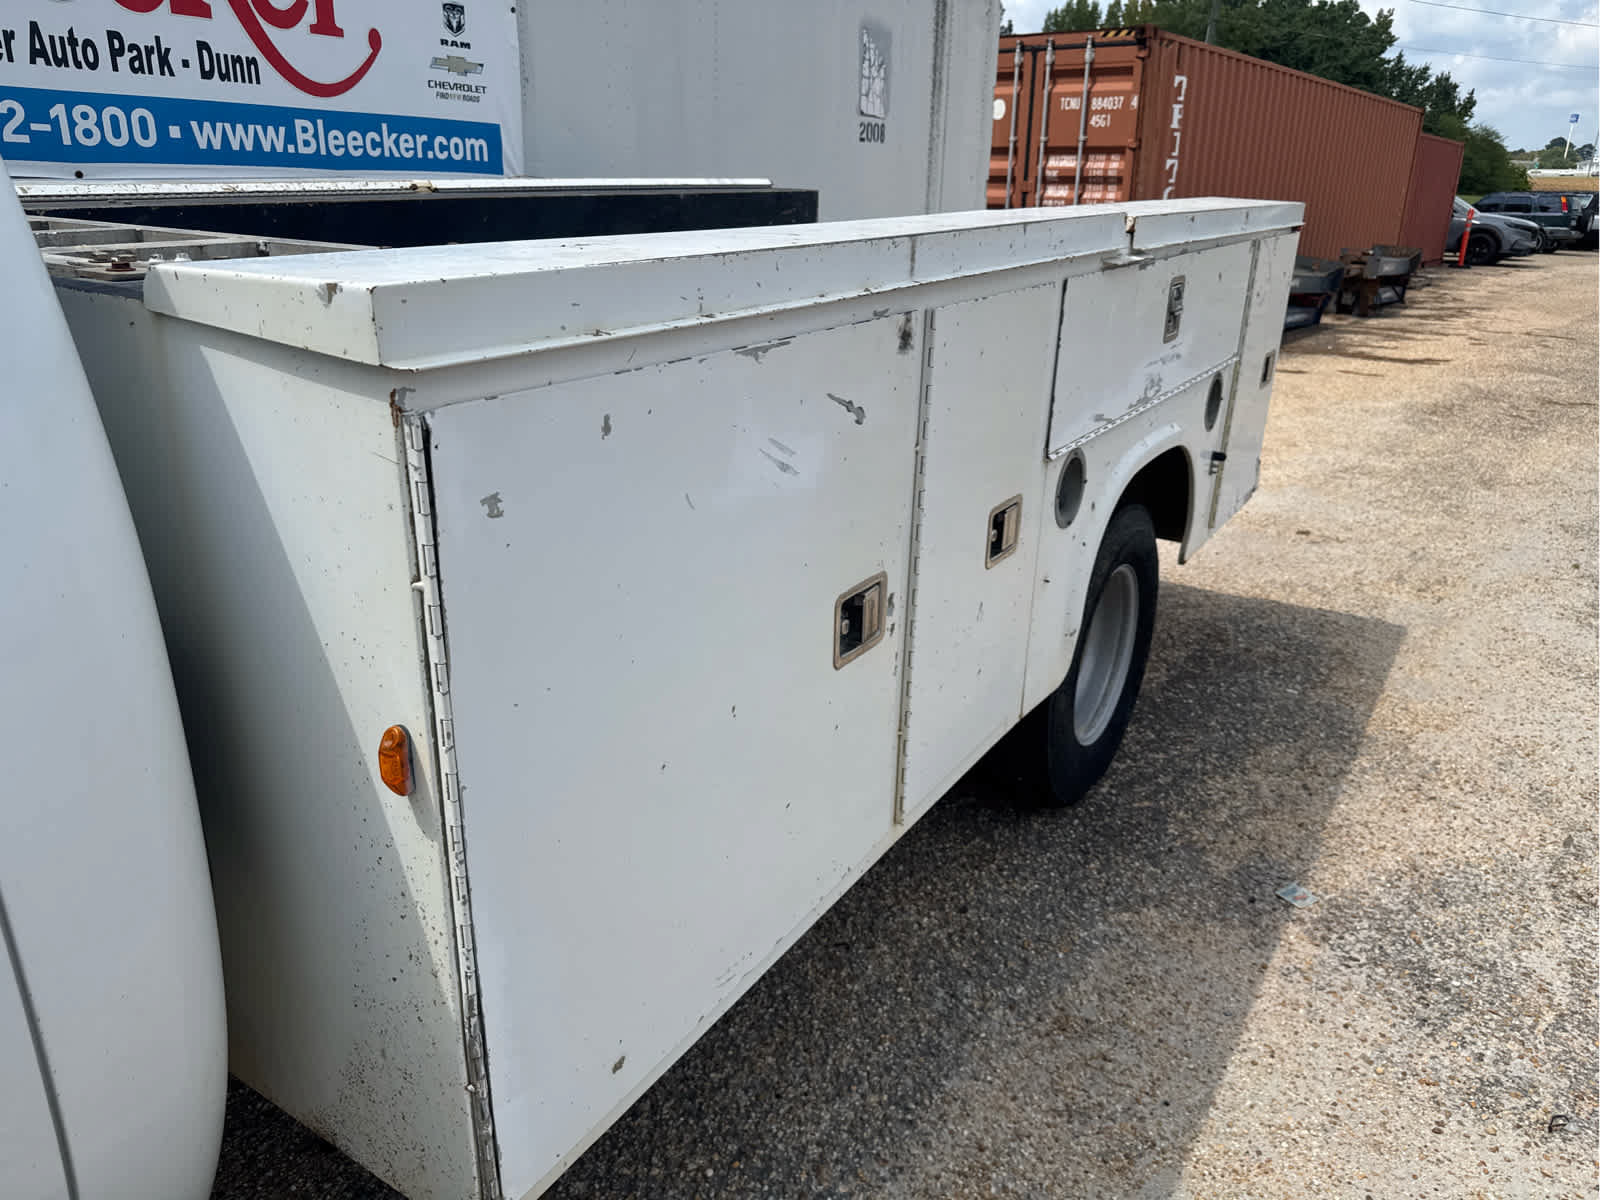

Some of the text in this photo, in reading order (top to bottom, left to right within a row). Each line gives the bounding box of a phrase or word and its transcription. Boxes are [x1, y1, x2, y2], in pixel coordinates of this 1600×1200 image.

[28, 20, 100, 71] Auto
[106, 29, 176, 77] Park
[196, 39, 261, 85] Dunn
[440, 38, 471, 50] RAM
[428, 80, 487, 94] CHEVROLET
[190, 118, 489, 162] www.Bleecker.com
